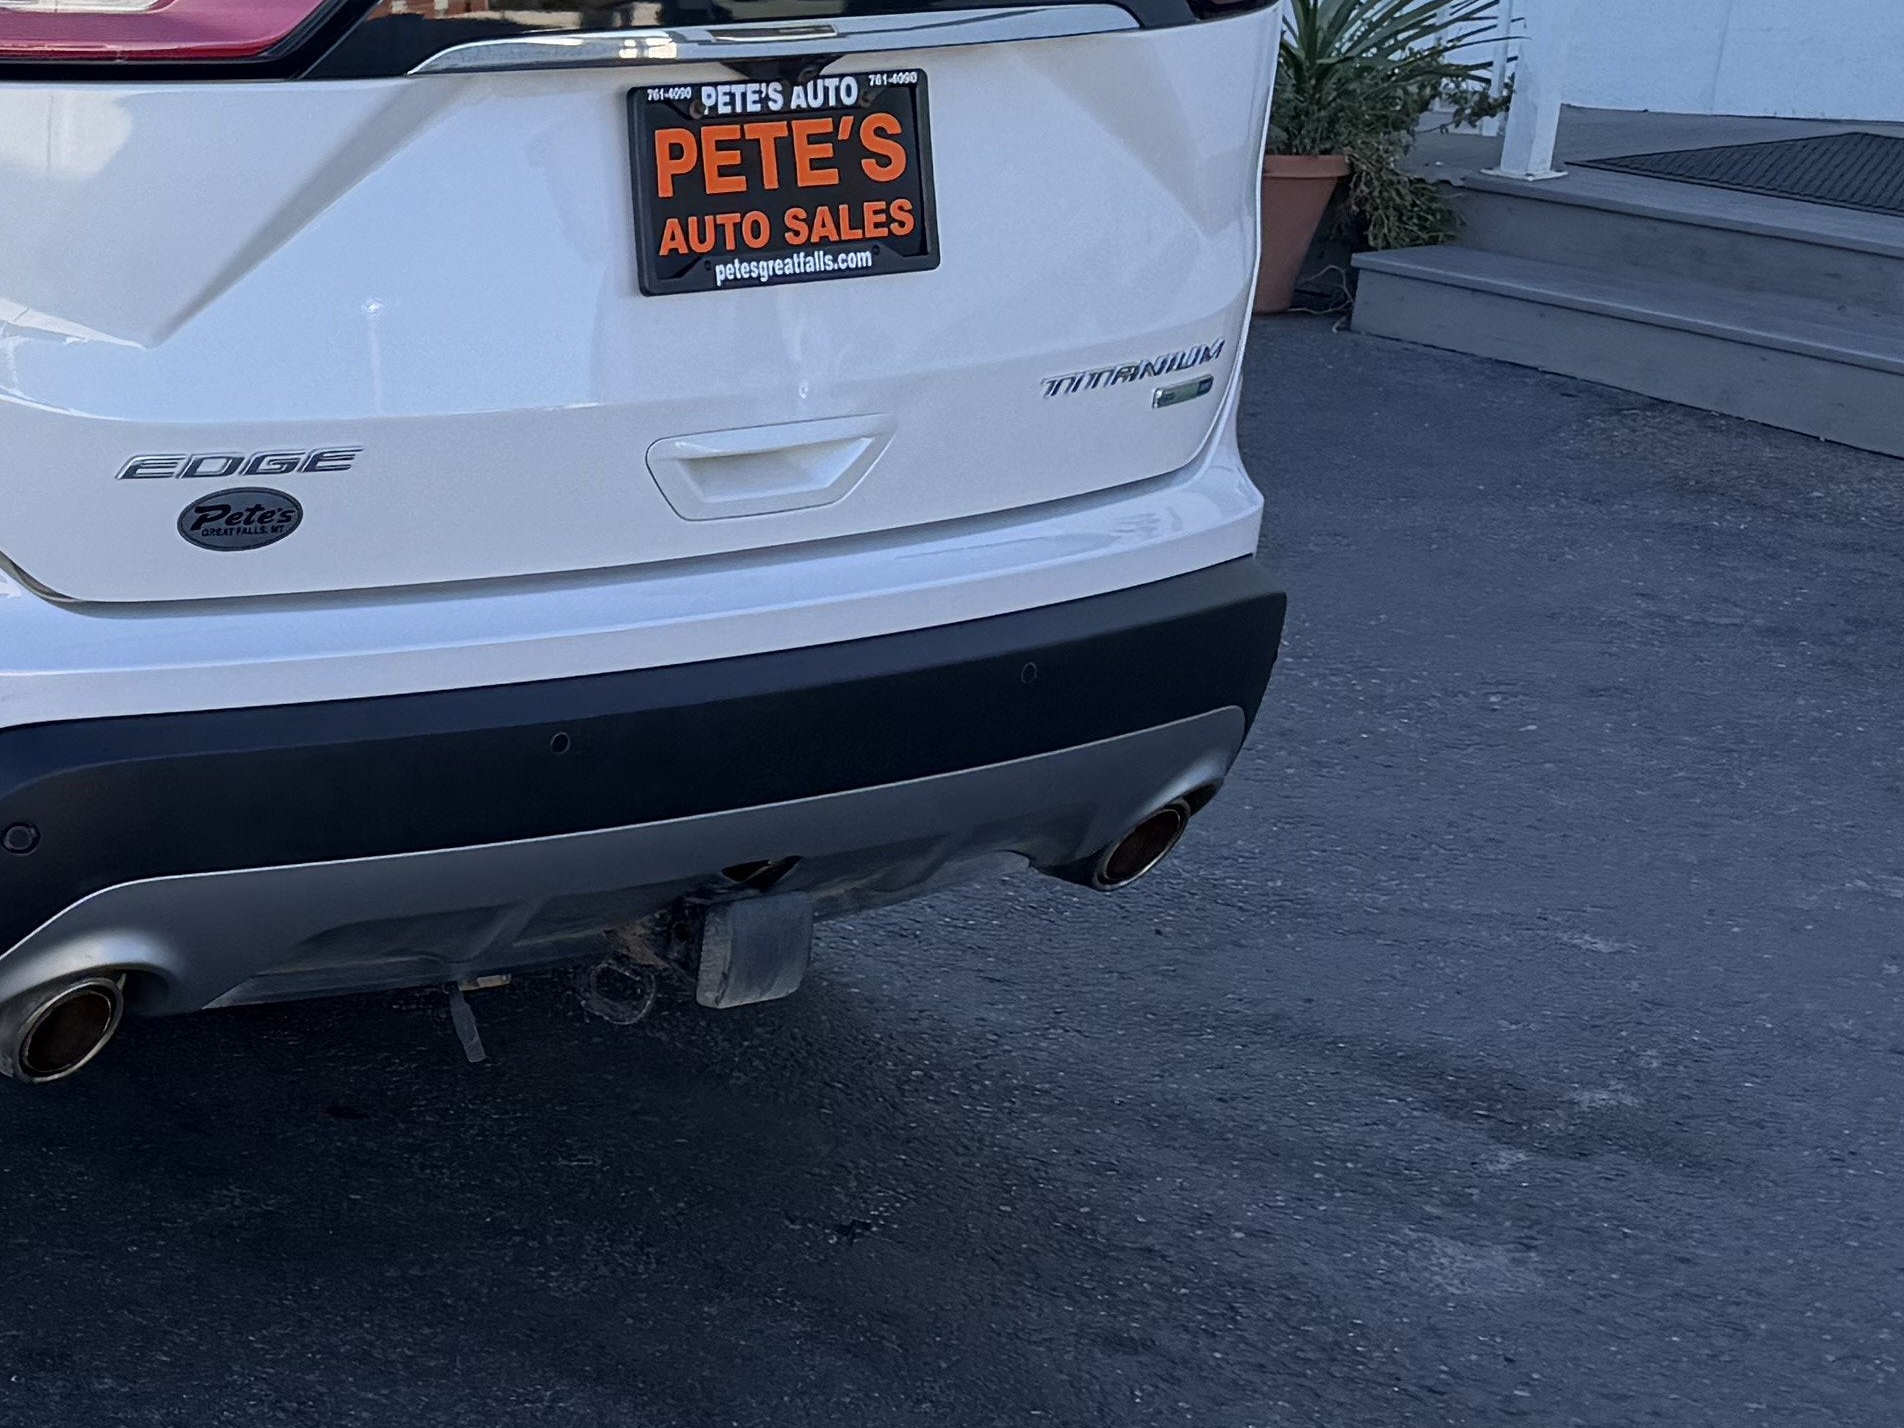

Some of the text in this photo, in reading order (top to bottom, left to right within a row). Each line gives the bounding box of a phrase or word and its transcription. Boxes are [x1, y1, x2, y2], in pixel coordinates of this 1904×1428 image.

[701, 76, 858, 115] PETE'S AUTO
[655, 113, 907, 198] PETE'S
[659, 198, 915, 256] AUTO SALES
[715, 249, 872, 286] petesgreatfalls.com
[1041, 337, 1226, 398] TITANIUM
[115, 445, 364, 480] EDGE
[191, 504, 296, 531] Pete's
